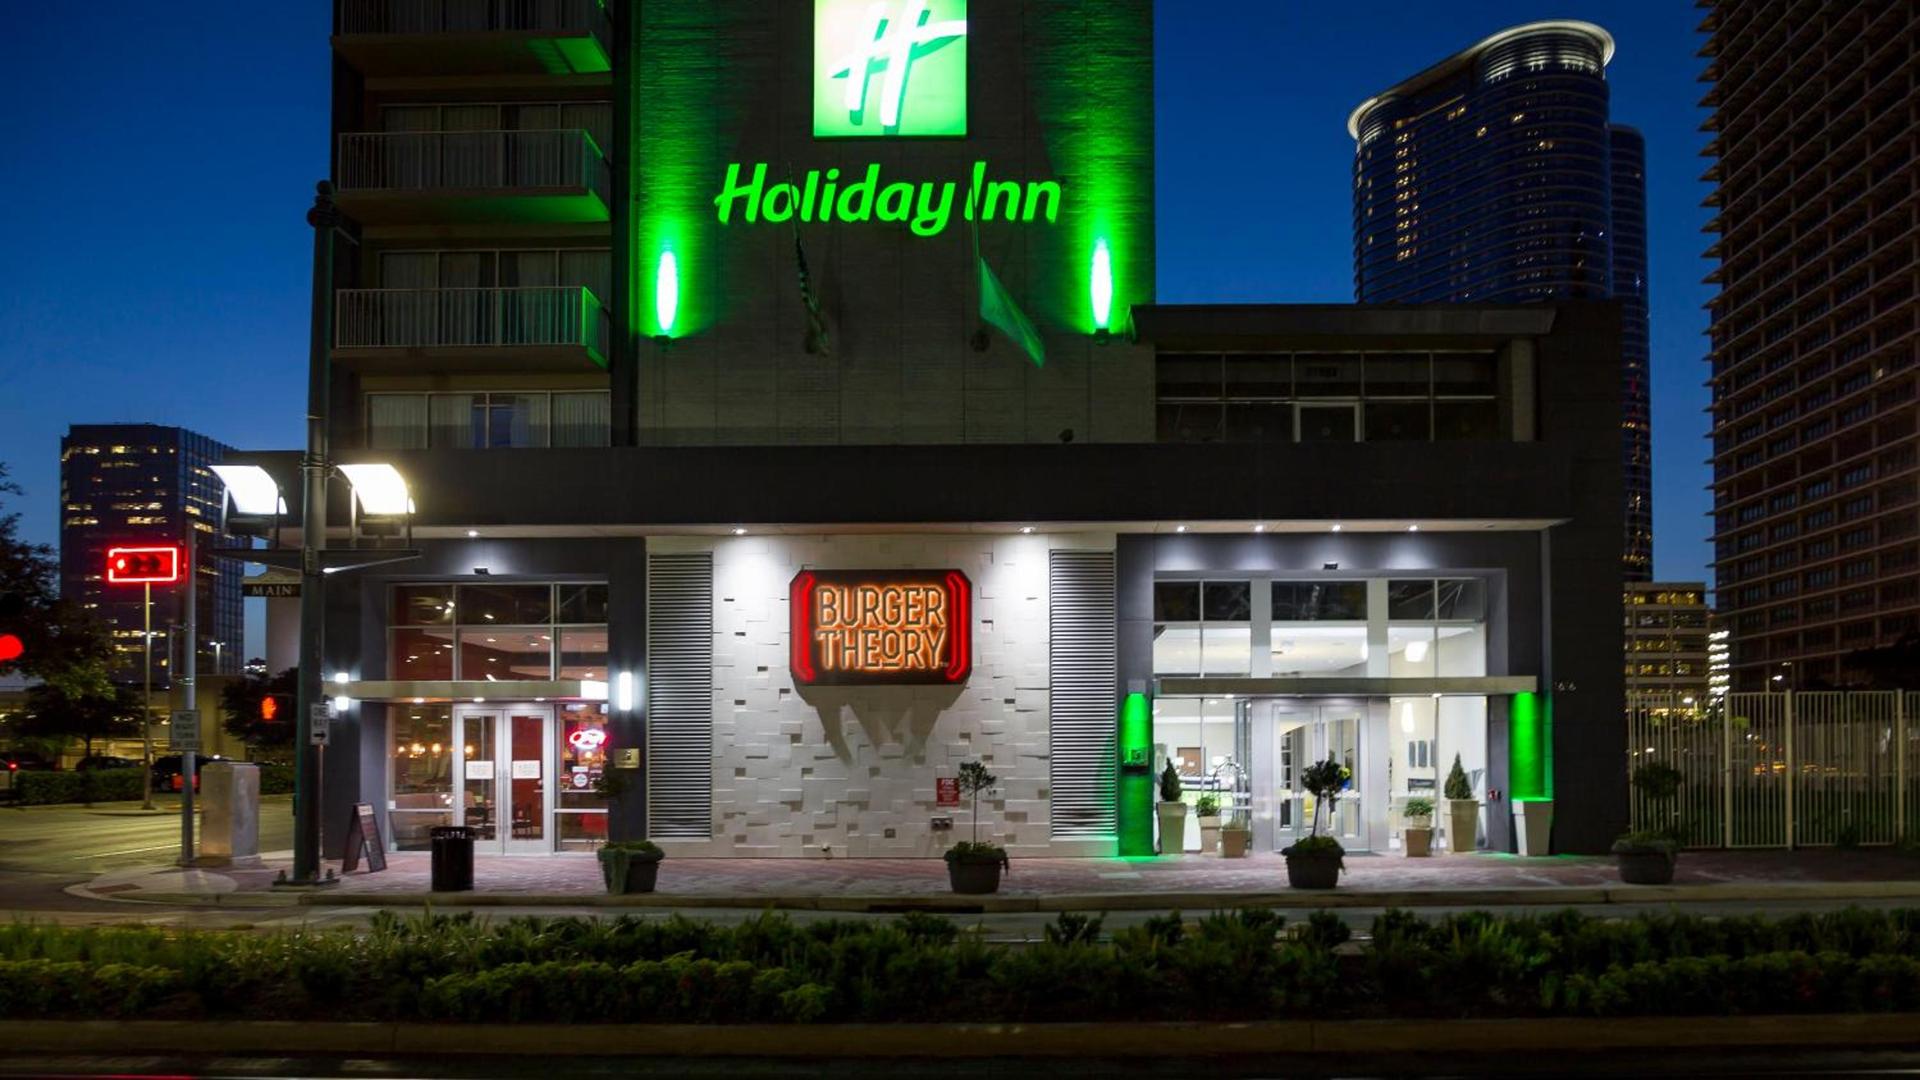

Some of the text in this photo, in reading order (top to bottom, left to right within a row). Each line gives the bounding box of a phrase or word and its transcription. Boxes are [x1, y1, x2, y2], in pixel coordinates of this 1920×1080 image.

[714, 161, 1062, 237] Holiday Inn
[252, 586, 292, 596] MAIN
[815, 585, 945, 627] BURGER
[815, 628, 946, 669] THEORY
